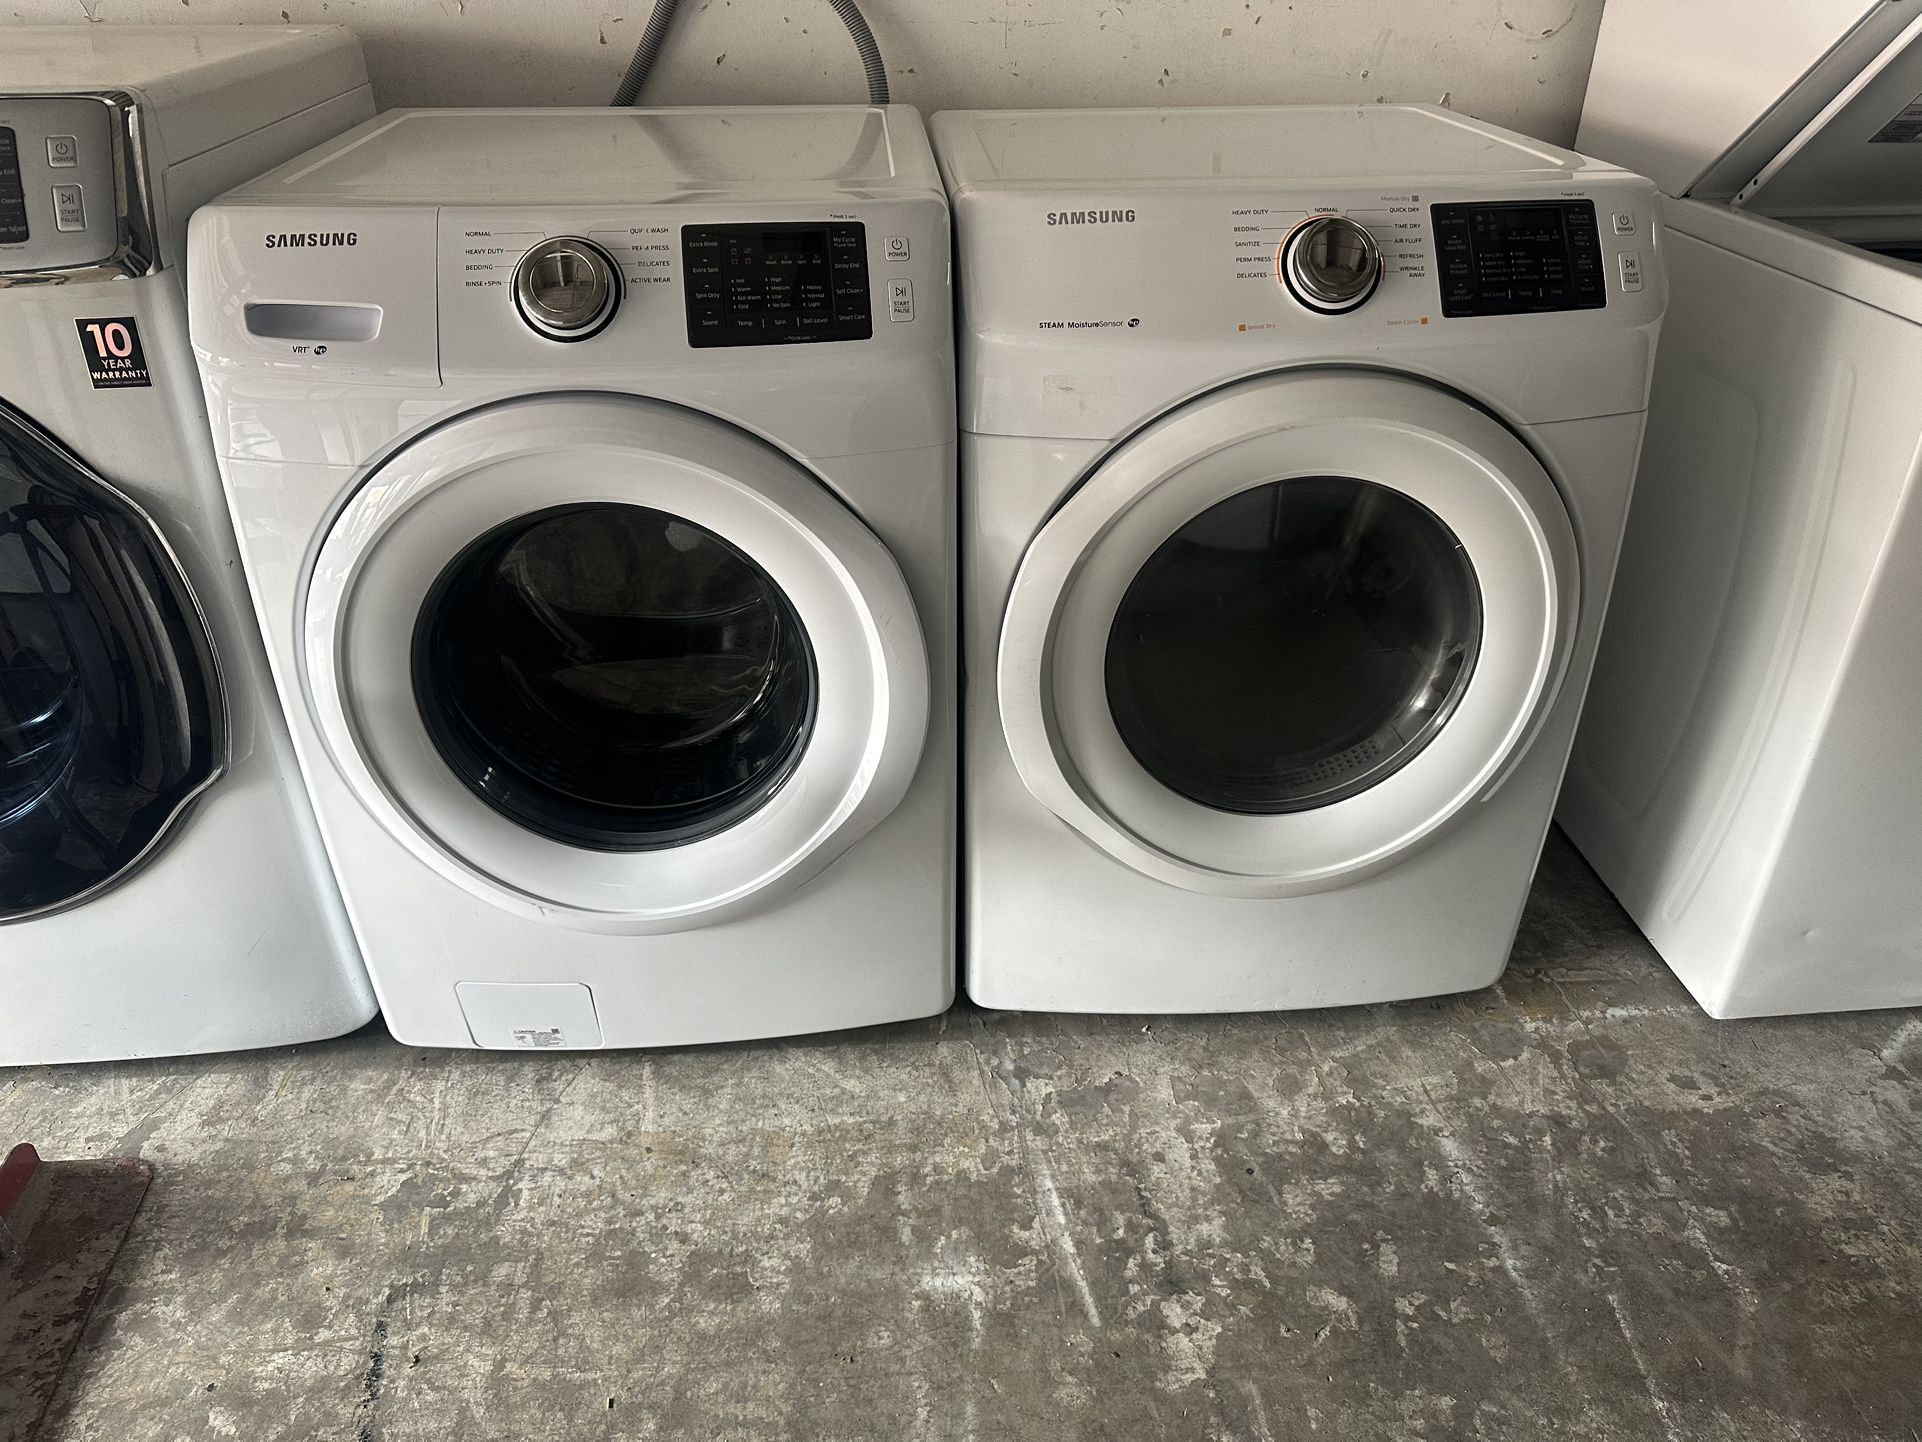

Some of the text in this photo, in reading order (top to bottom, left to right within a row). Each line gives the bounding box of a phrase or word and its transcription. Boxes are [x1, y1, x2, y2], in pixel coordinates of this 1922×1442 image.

[1046, 209, 1136, 226] SAMSUNG
[265, 232, 358, 249] SAMSUNG
[86, 322, 132, 357] 10
[101, 358, 133, 369] YEAR
[91, 369, 147, 380] WARRANTY
